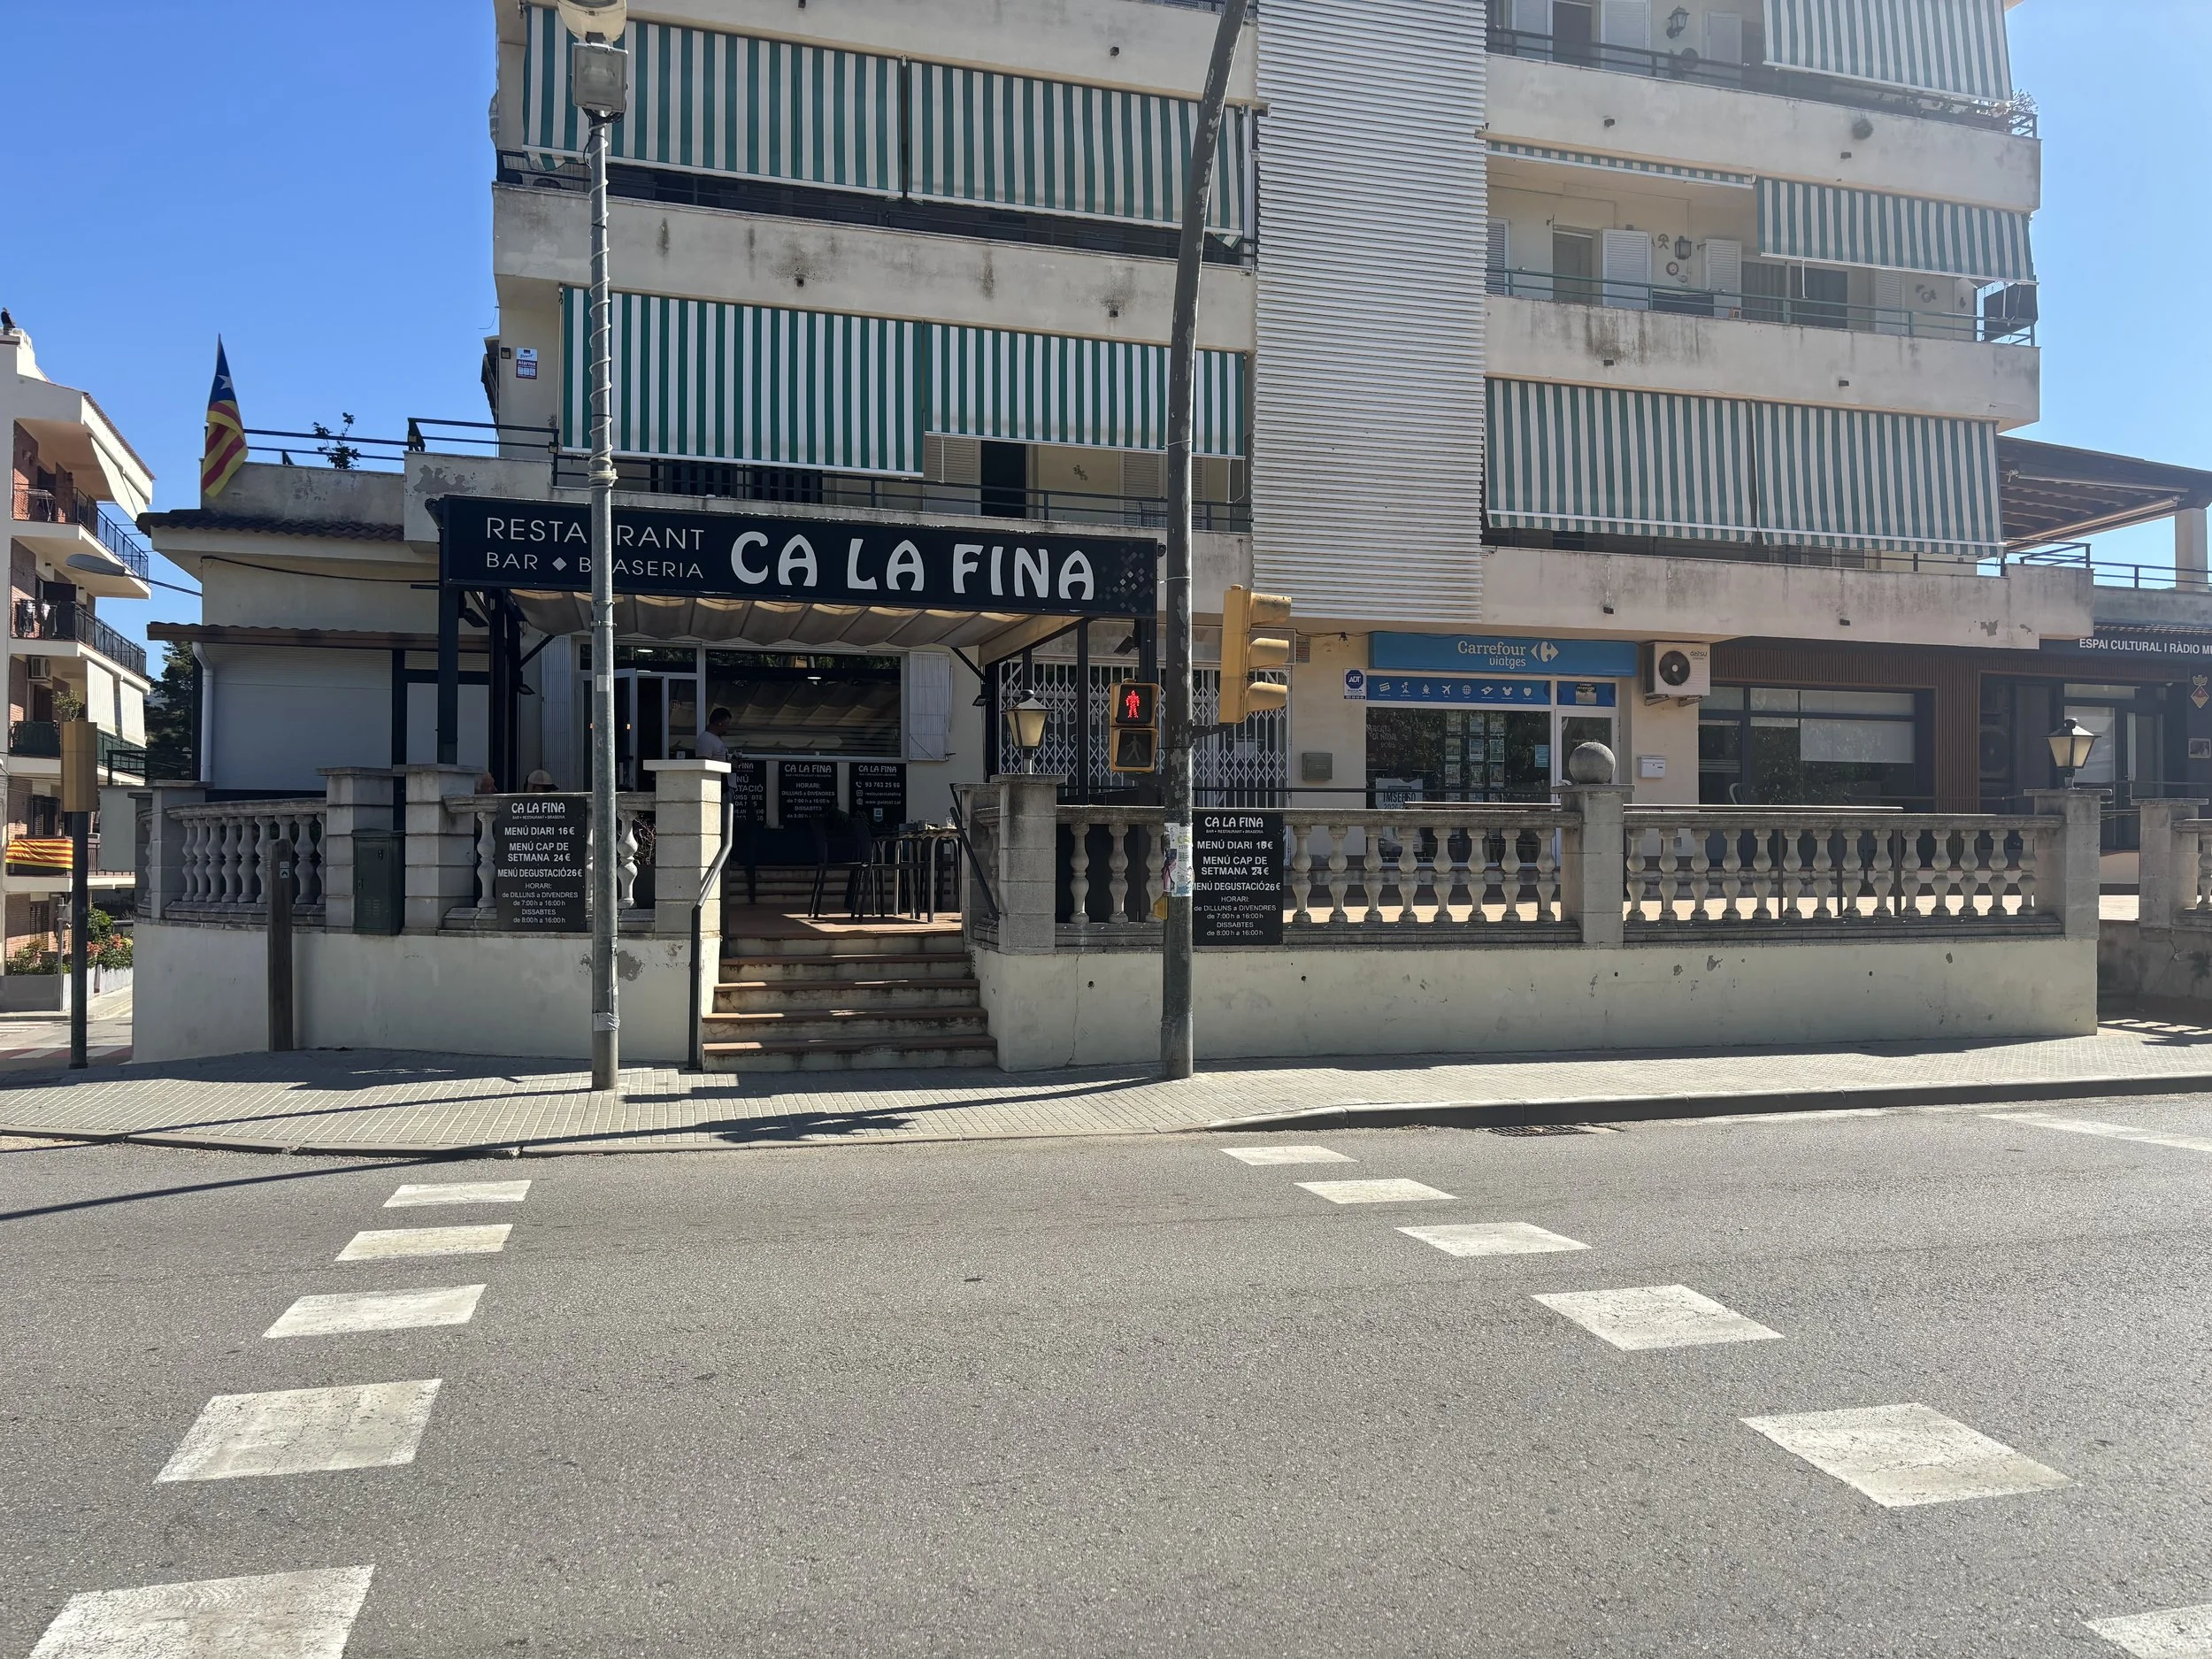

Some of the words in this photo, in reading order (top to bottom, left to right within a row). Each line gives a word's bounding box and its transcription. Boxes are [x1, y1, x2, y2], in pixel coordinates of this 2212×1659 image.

[487, 517, 704, 550] RESTARANT
[487, 552, 538, 570] BAR
[579, 557, 704, 579] BASERIA
[731, 531, 818, 588] CA
[847, 538, 925, 592] LA
[952, 543, 1094, 601] FINA
[1458, 641, 1526, 656] Carrefour
[2079, 638, 2108, 649] ESPAI
[2110, 640, 2162, 652] CULTURAL
[2164, 642, 2168, 653] I
[2170, 641, 2200, 655] RÀDIO
[798, 764, 810, 773] LA
[812, 764, 832, 773] FINA
[511, 803, 524, 813] CA
[526, 803, 539, 813] LA
[541, 802, 565, 813] FINA
[1204, 817, 1219, 827] CA
[1223, 817, 1236, 827] LA
[1239, 817, 1263, 827] FINA
[504, 825, 528, 835] MENÚ
[531, 826, 555, 835] DIARI
[509, 841, 534, 851] MENÚ
[535, 842, 554, 851] CAP
[557, 842, 569, 851] DE
[1197, 839, 1225, 849] MENÚ
[1227, 841, 1253, 849] DIARI
[508, 853, 550, 862] SETMANA
[1202, 855, 1230, 864] MENÚ
[497, 867, 518, 877] MENÚ
[519, 867, 566, 878] DEGUSTACIÓ
[1214, 880, 1264, 891] DEGUSTACIÓ
